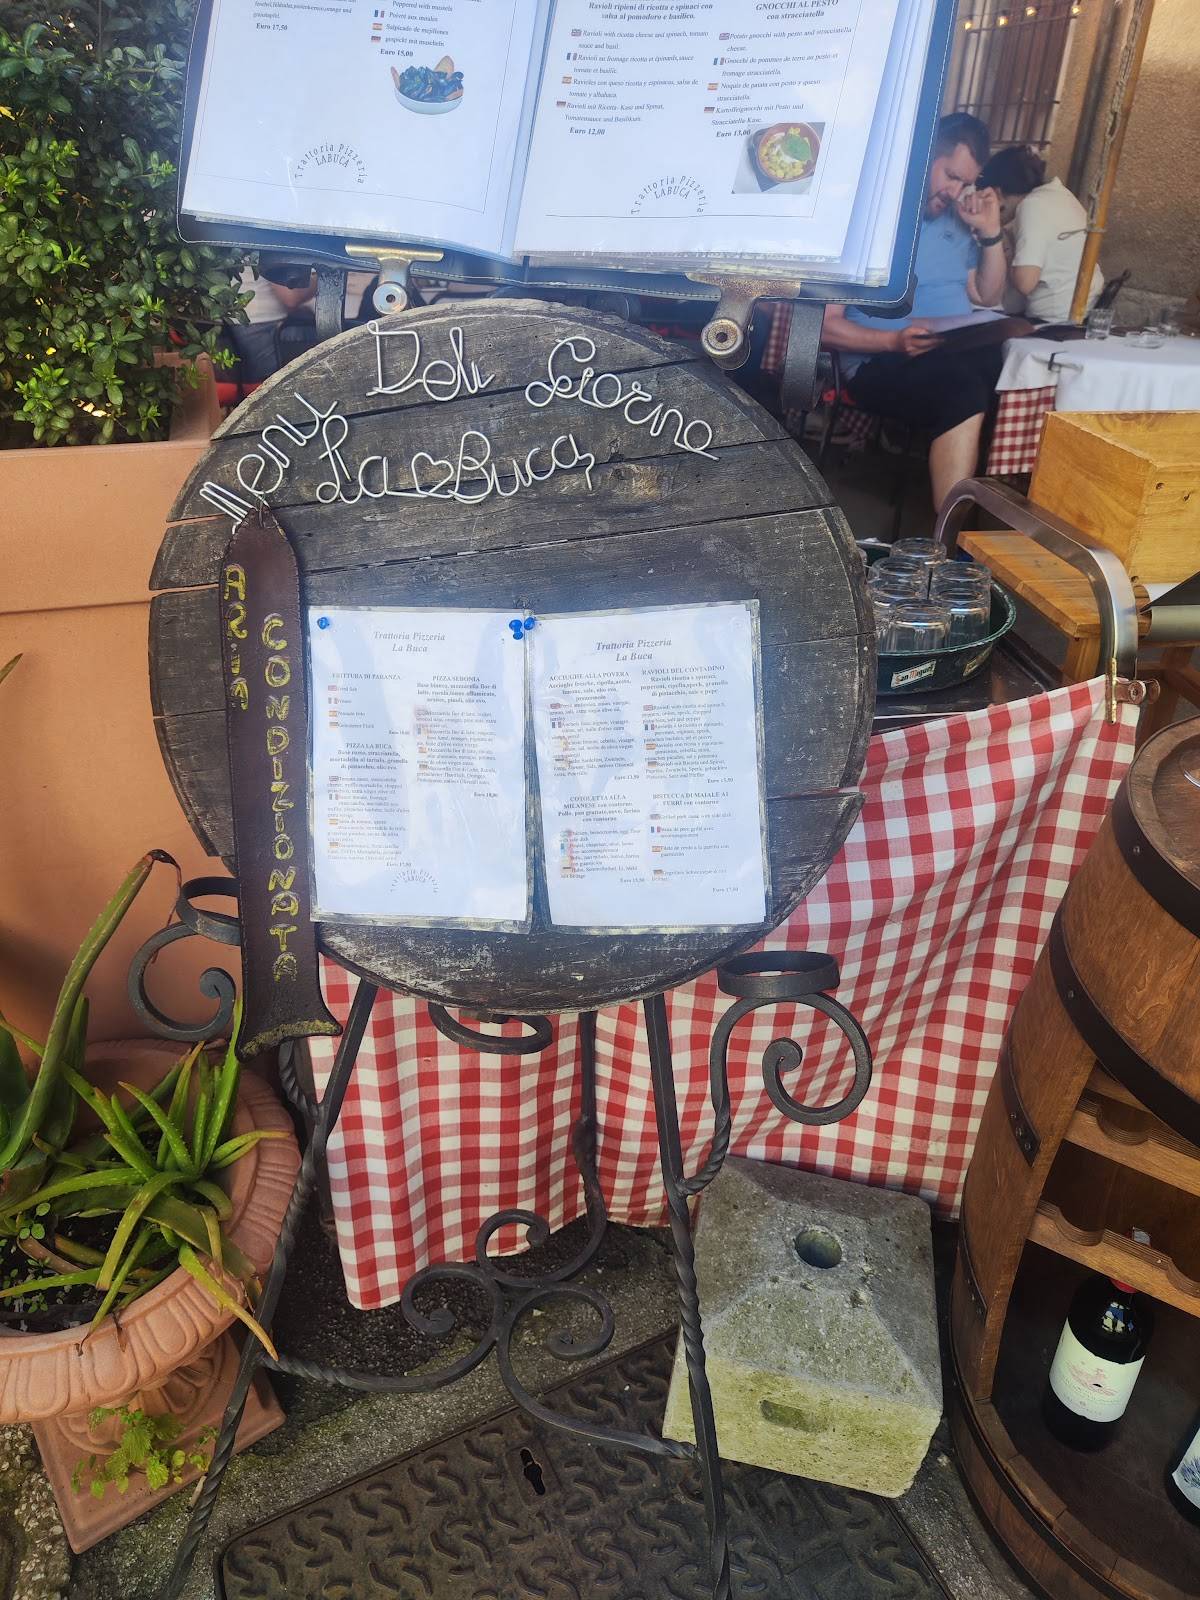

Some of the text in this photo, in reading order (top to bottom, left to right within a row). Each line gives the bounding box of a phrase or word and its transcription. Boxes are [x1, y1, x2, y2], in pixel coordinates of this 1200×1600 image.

[588, 2, 612, 10] Ravioli
[614, 3, 637, 12] ripieni
[674, 4, 700, 12] spinaci
[756, 2, 796, 11] GNOCCHI
[798, 0, 810, 8] AL
[628, 14, 662, 22] pomodoro
[780, 10, 825, 20] stracciatella
[749, 32, 772, 40] gnocchi
[380, 48, 396, 56] Euro
[566, 102, 588, 110] Ravioli
[716, 130, 732, 138] Euro
[294, 141, 368, 184] Trattoria Pizzeria
[630, 175, 708, 215] Trattoria Pizzeria
[199, 392, 338, 531] Menu
[373, 631, 446, 642] Trattoria Pizzeria
[392, 644, 428, 653] La Buca
[596, 638, 673, 651] Trattoria Pizzeria
[616, 652, 654, 662] La Buca
[345, 742, 365, 750] PIZZA
